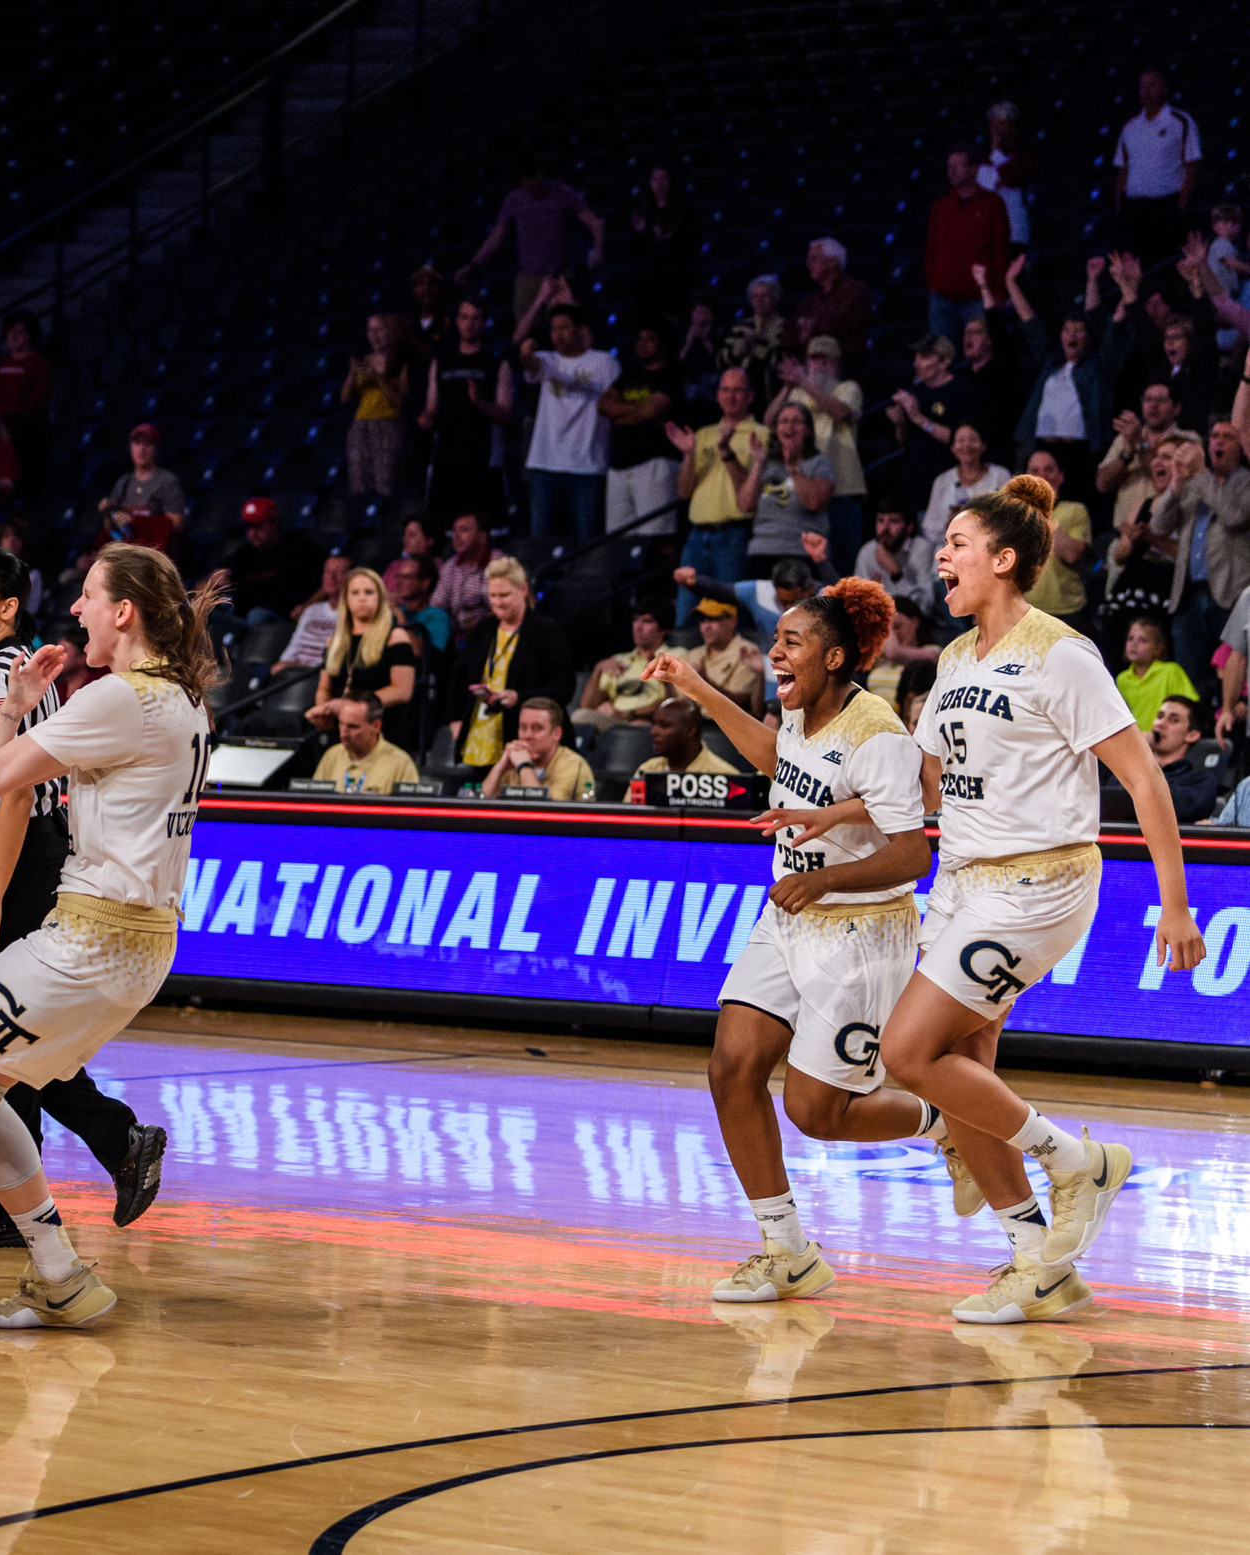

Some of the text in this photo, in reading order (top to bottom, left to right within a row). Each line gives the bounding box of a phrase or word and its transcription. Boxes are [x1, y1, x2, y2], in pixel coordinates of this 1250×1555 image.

[993, 663, 1027, 676] ACC
[939, 721, 967, 765] 15
[822, 749, 844, 766] ACC
[666, 773, 729, 799] POSS
[180, 857, 541, 953] NATIONAL
